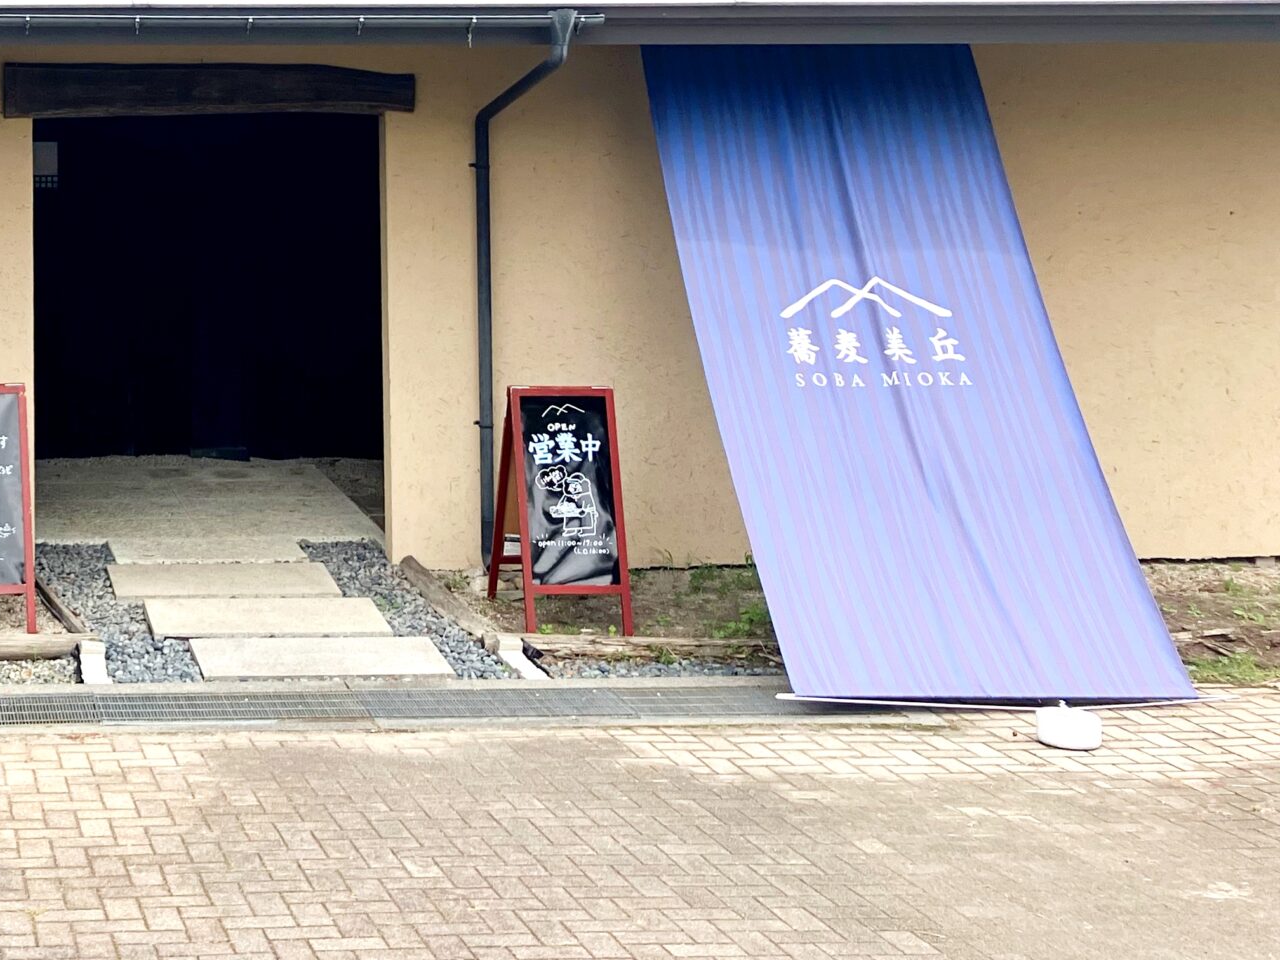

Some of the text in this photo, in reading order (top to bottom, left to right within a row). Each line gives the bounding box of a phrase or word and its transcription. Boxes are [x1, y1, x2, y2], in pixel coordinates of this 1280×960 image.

[787, 327, 966, 365] 蕎麦美丘
[795, 371, 973, 387] SOBA MIOKA
[547, 422, 576, 432] OPEN
[528, 432, 601, 465] 営業中
